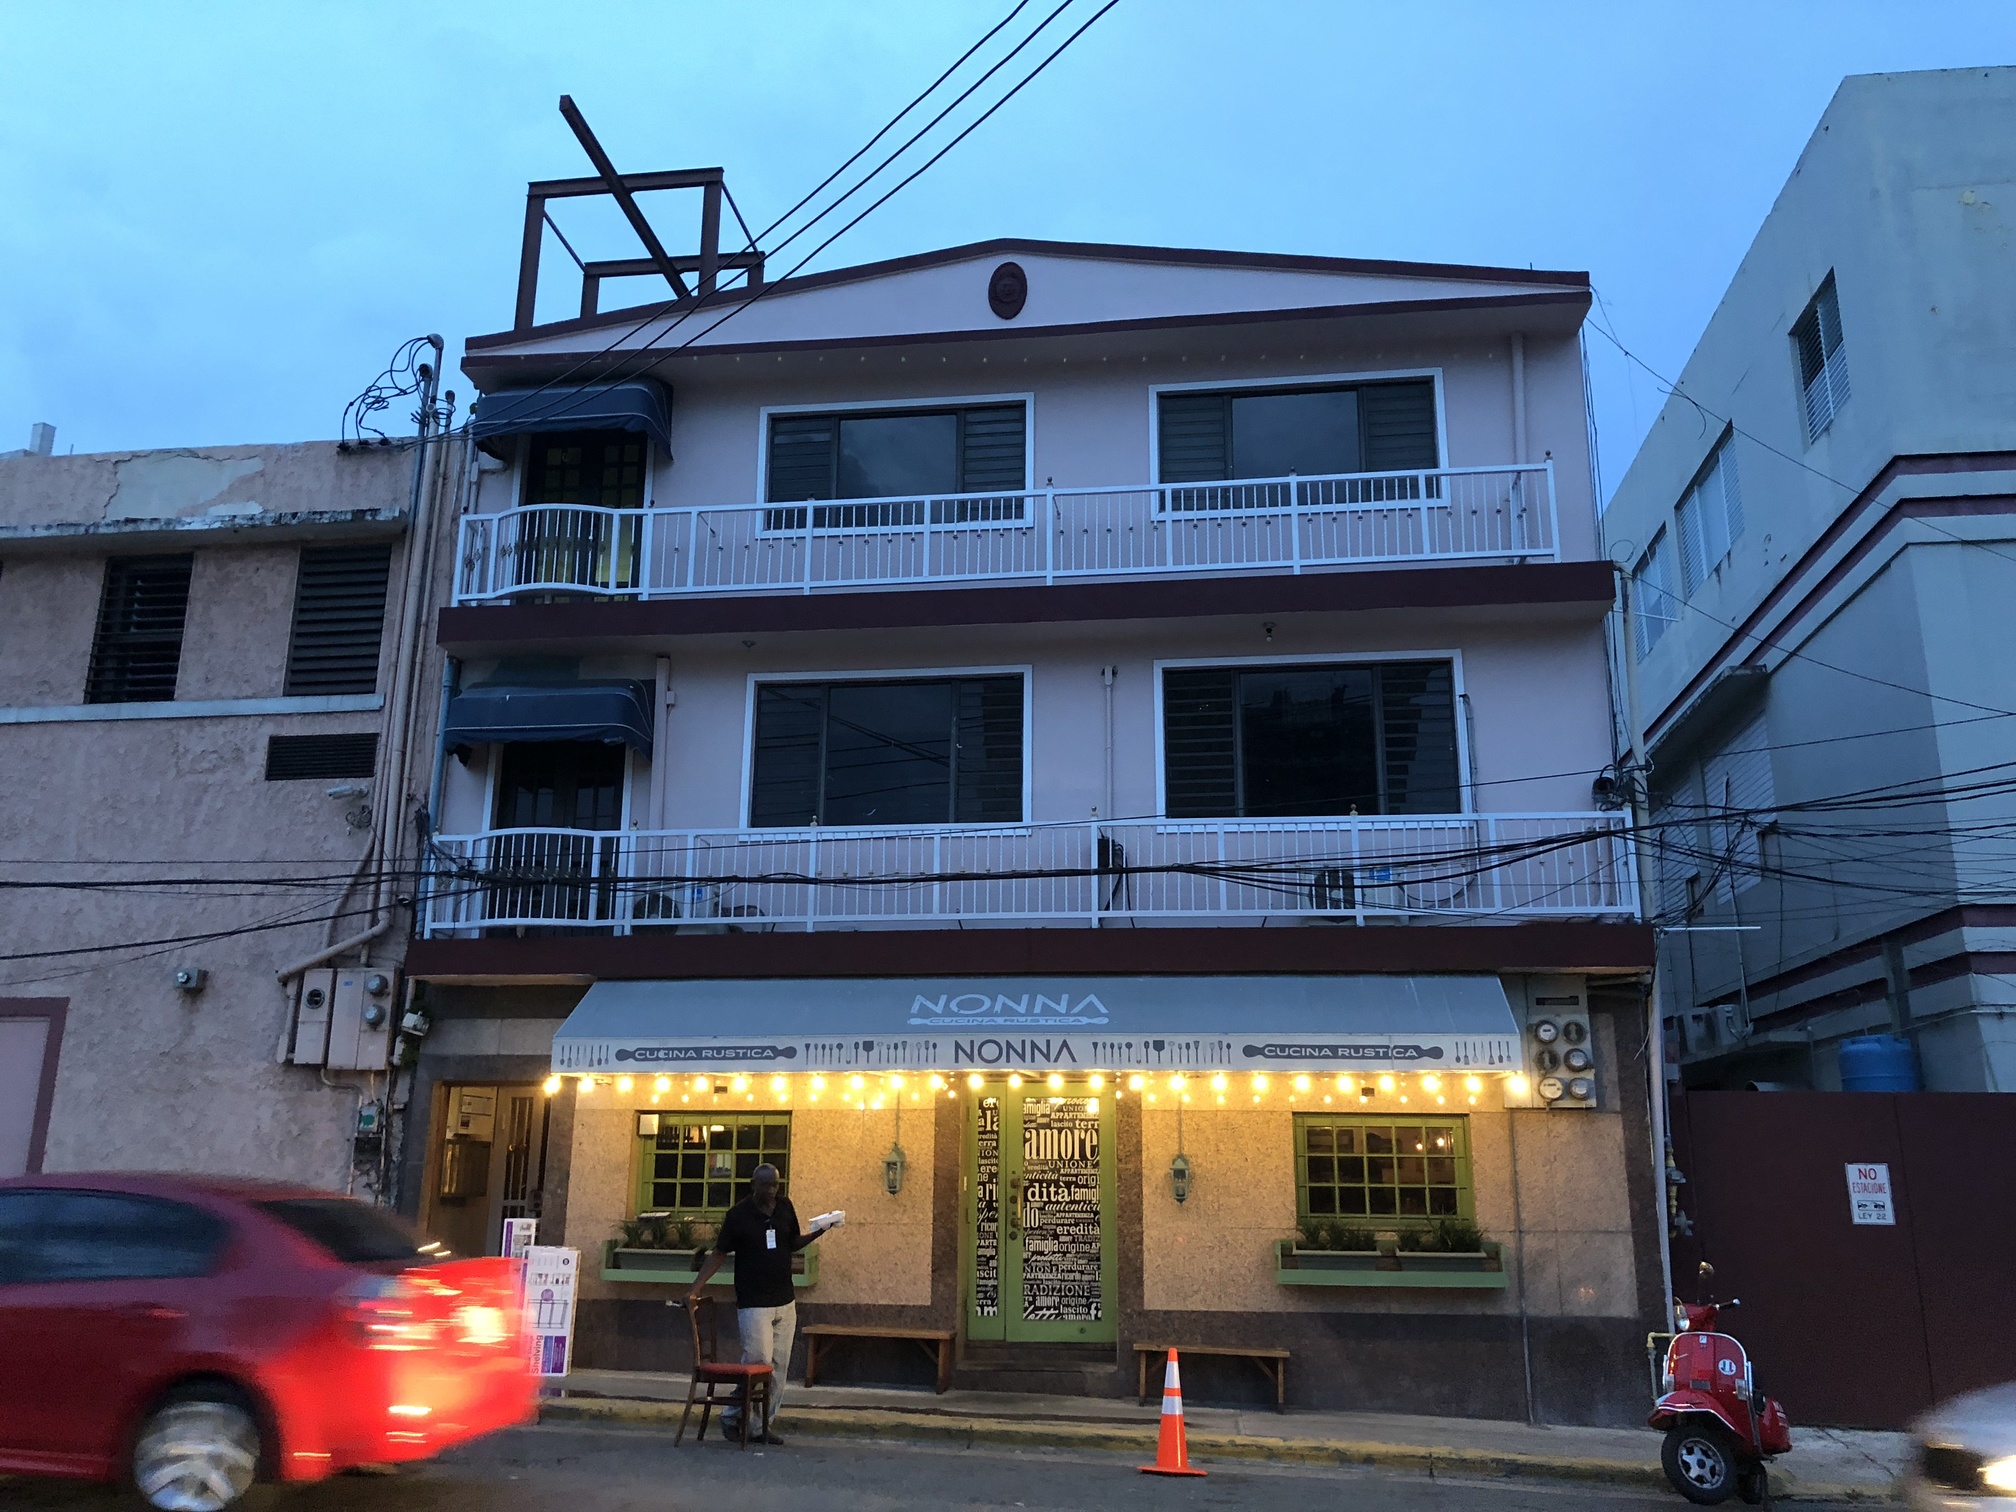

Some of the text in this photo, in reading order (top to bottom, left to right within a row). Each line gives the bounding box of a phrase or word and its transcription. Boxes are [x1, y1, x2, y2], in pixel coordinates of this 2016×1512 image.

[910, 993, 1109, 1014] NONNA
[635, 1048, 775, 1059] CUCINA RUSTICA
[954, 1038, 1077, 1064] NONNA
[1264, 1046, 1419, 1058] CUCINA RUSTICA
[1025, 1129, 1098, 1161] amore
[1048, 1160, 1093, 1169] UNIONE
[1858, 1168, 1877, 1181] NO
[1027, 1181, 1070, 1202] dità
[1852, 1182, 1887, 1194] ESTACIONE
[1858, 1212, 1887, 1221] LEY 22
[1056, 1223, 1100, 1236] eredità
[1025, 1236, 1059, 1255] famiglia
[1059, 1242, 1090, 1255] origine
[1061, 1296, 1087, 1306] origine
[1060, 1303, 1089, 1314] lascito
